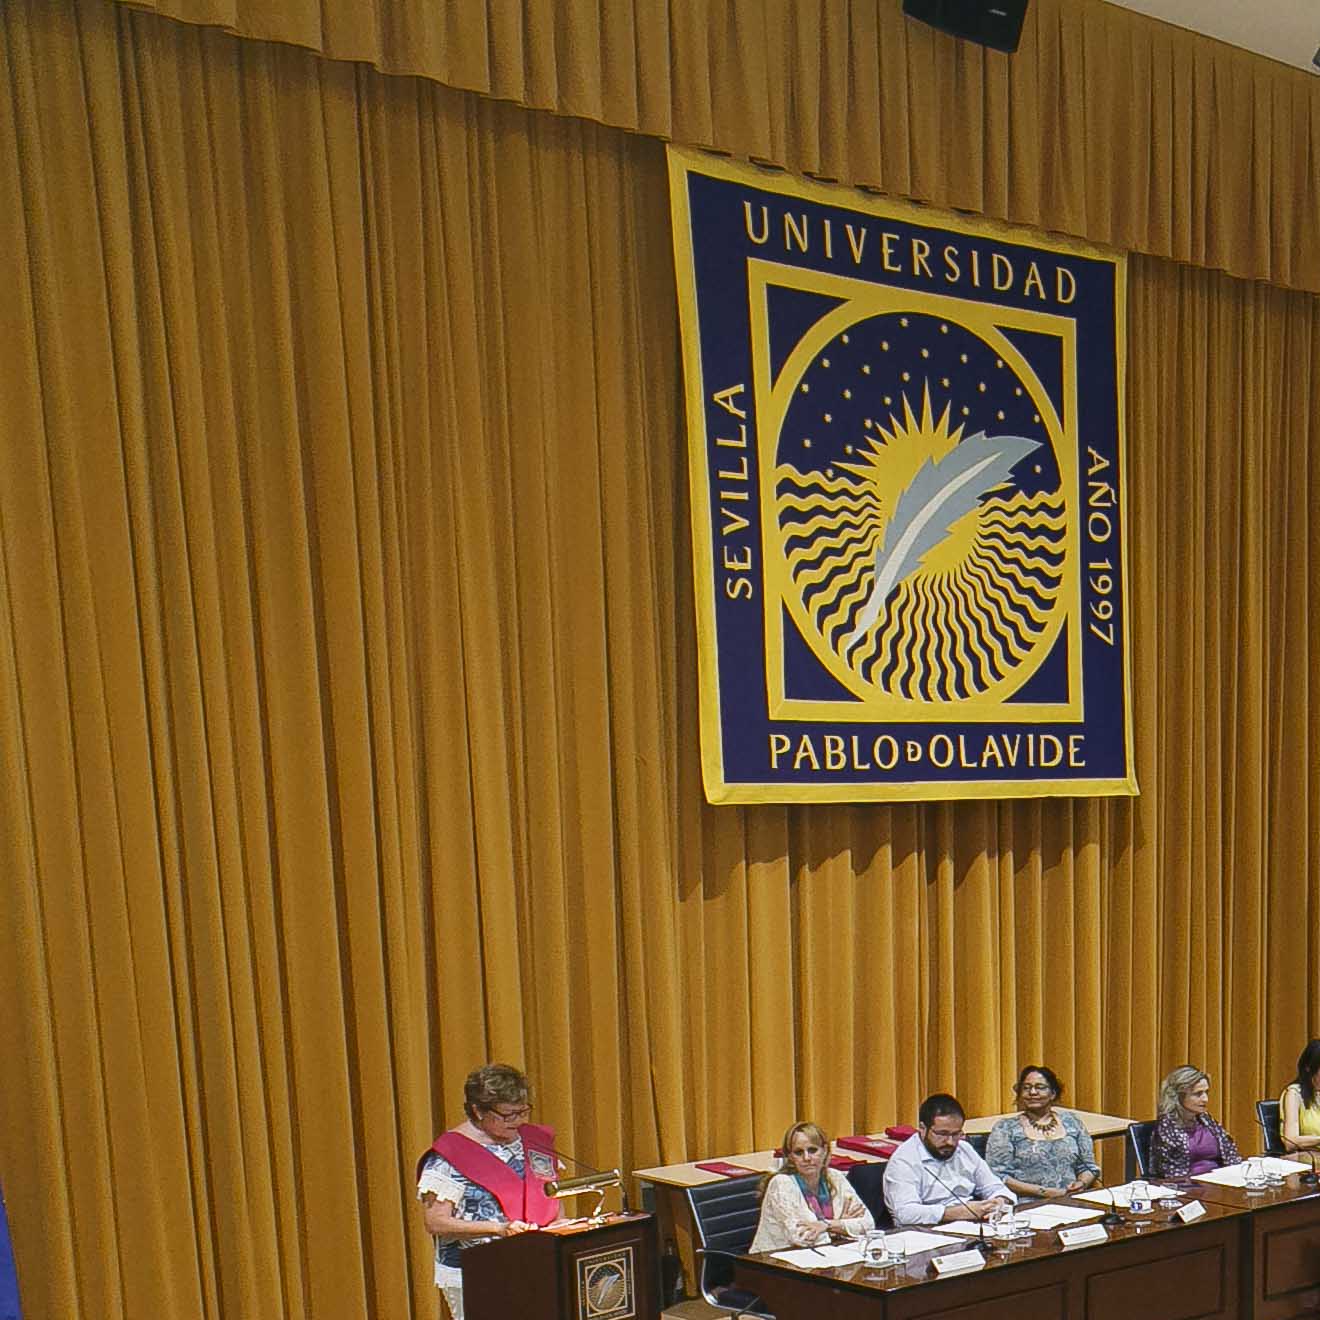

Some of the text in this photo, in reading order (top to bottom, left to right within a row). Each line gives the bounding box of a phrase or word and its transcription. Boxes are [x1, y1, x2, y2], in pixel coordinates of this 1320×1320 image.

[743, 200, 1078, 304] UNIVERSIDAD
[713, 383, 753, 600] SEVILLA
[1087, 445, 1117, 646] AÑO 1997
[768, 734, 899, 770] PABLO
[928, 734, 1086, 768] OLAVIDE
